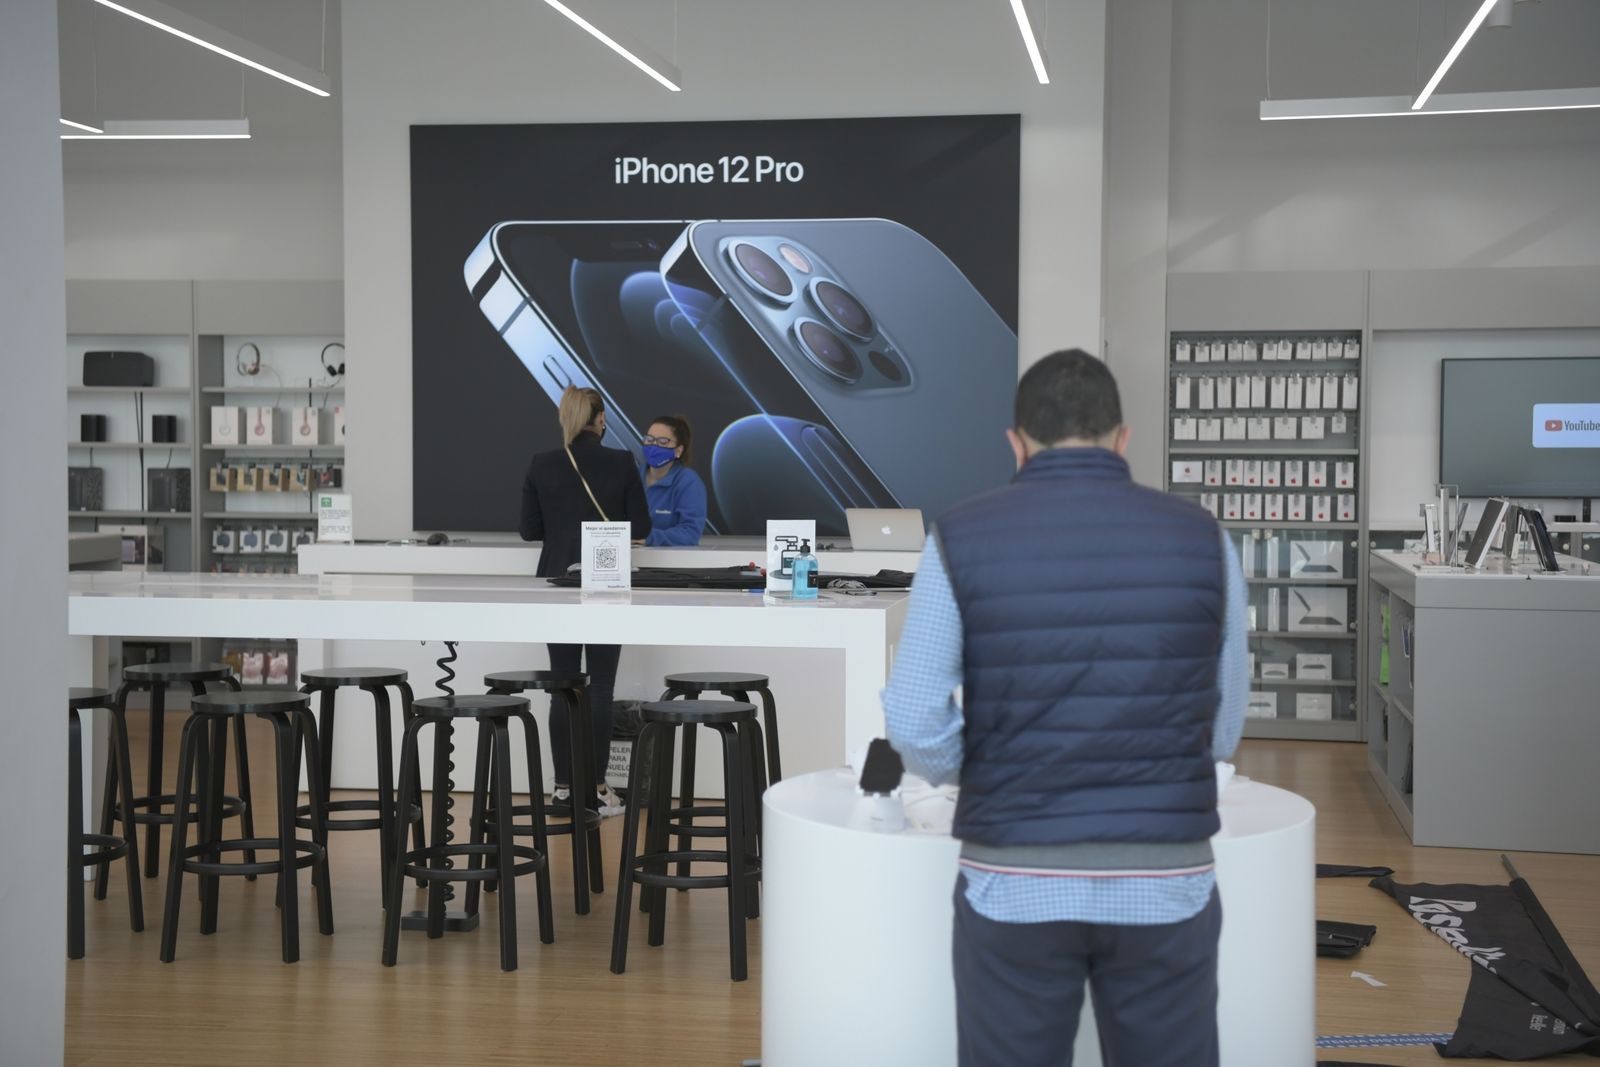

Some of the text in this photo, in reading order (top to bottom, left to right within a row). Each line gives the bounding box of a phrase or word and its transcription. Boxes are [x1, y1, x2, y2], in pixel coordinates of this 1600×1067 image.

[615, 155, 804, 184] iPhone 12 Pro
[1564, 420, 1600, 431] YouTube
